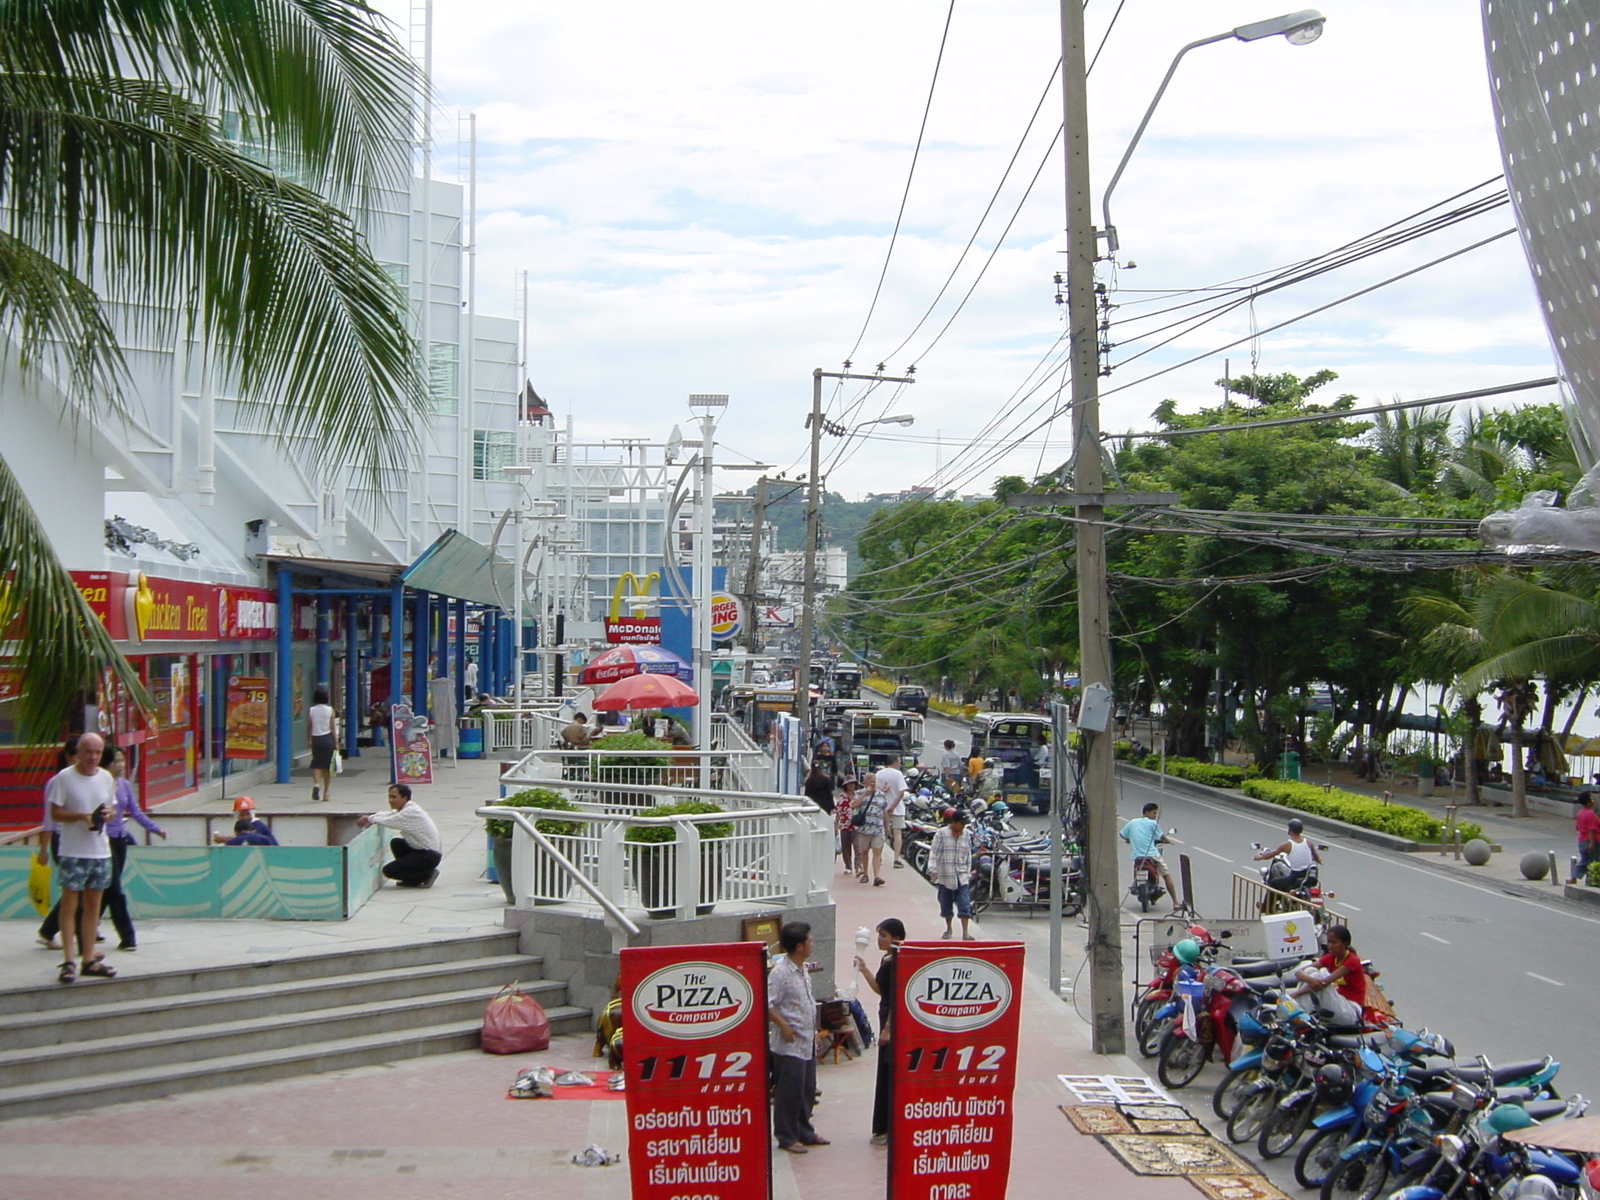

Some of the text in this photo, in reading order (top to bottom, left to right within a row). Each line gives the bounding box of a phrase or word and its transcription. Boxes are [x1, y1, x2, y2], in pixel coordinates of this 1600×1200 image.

[186, 595, 209, 632] Treat
[1280, 944, 1304, 953] 1112
[683, 973, 706, 986] The
[952, 968, 973, 980] The
[656, 984, 734, 1009] PIZZA
[926, 977, 995, 1001] PIZZA
[668, 1010, 721, 1023] Company
[935, 1004, 982, 1016] Company
[634, 1106, 701, 1131] อร่อยกับ
[904, 1096, 962, 1119] อร่อยกับ
[646, 1129, 741, 1157] รสชาติเยี่ยม
[913, 1118, 993, 1147] รสชาติเยี่ยม
[648, 1159, 740, 1185] เริ่มต้นเพียง
[913, 1148, 989, 1175] เริ่มต้นเพียง
